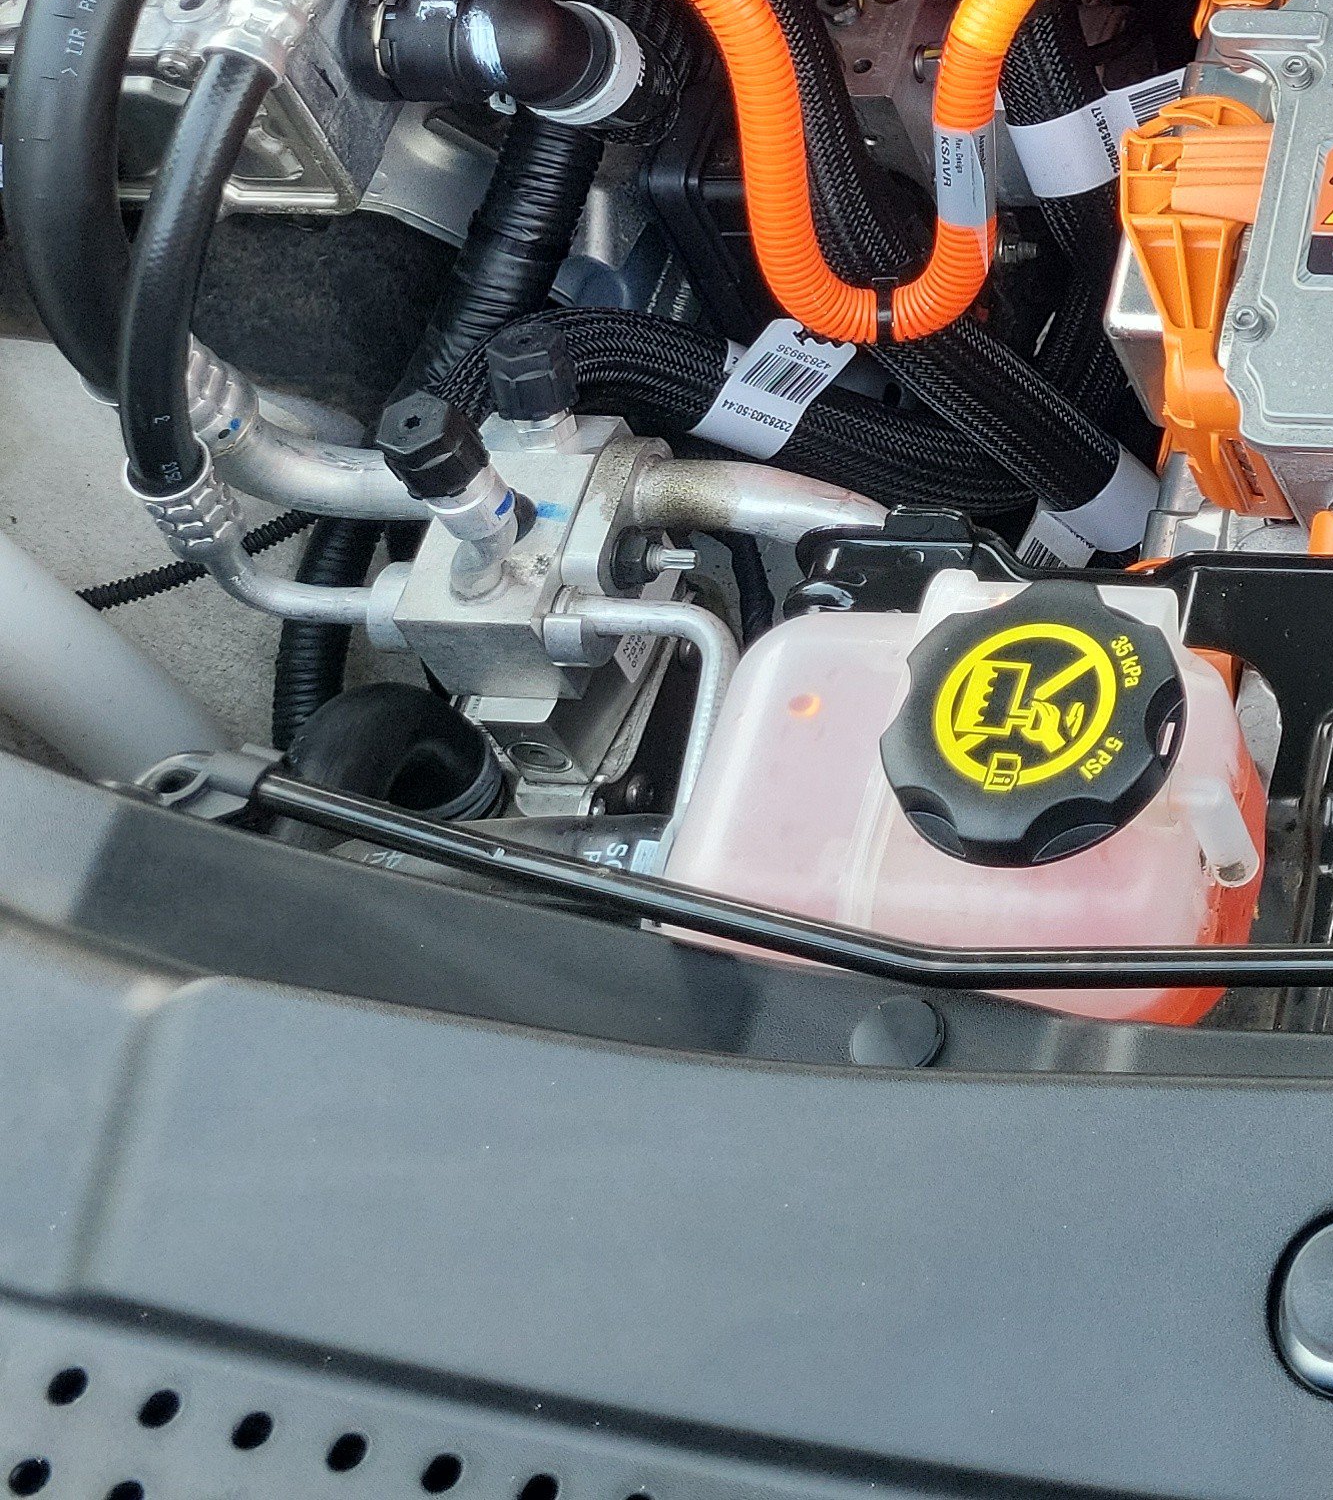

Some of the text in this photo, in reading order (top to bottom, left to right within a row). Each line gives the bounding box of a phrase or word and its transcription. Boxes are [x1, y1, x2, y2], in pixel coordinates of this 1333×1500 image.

[940, 134, 952, 187] KSAVR
[776, 343, 832, 370] 42838936
[1110, 635, 1142, 688] 35 kPa
[1079, 737, 1123, 781] 5 PSI
